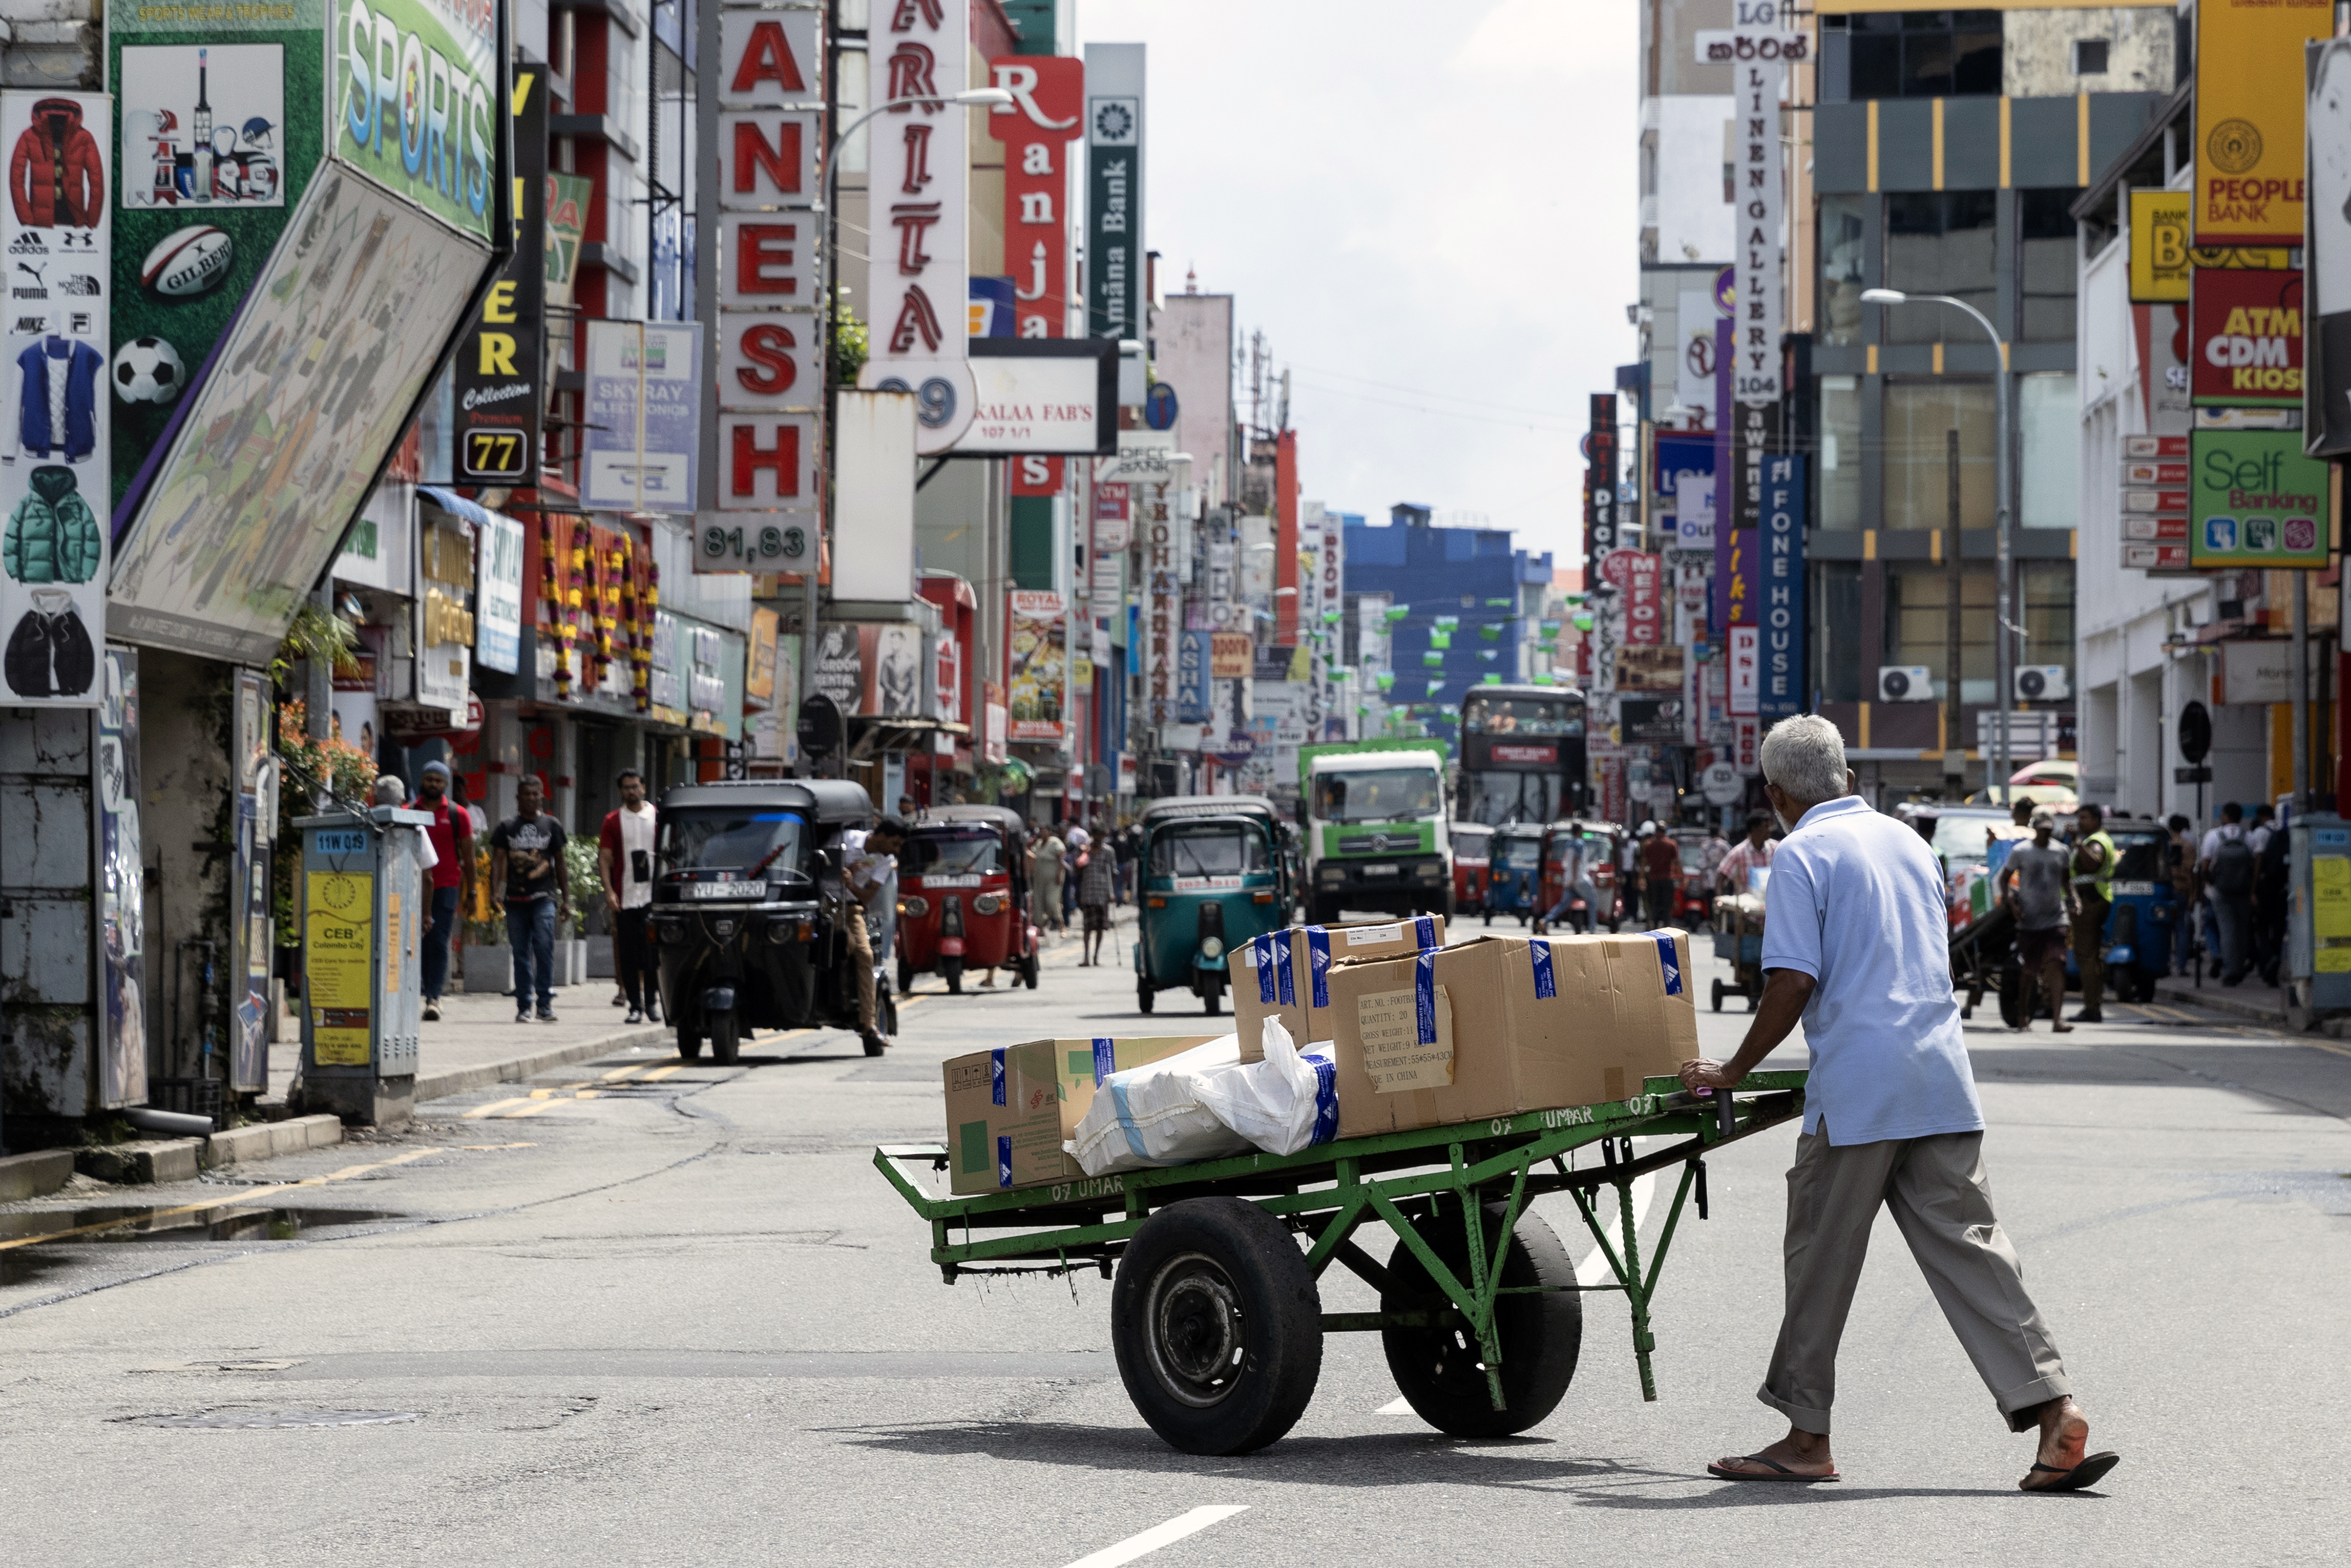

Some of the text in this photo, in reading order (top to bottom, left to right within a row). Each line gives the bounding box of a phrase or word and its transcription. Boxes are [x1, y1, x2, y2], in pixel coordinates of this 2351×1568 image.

[139, 6, 185, 21] SPORTS
[187, 5, 223, 21] WEAR
[236, 4, 294, 19] TROPHIES
[1738, 2, 1774, 25] LG
[349, 2, 489, 216] SPORTS
[1103, 159, 1126, 233] Bank
[2208, 203, 2269, 222] BANK
[8, 245, 49, 254] adidas
[731, 22, 806, 497] ANESH
[166, 239, 232, 290] GILBERT
[12, 287, 48, 300] PUMA
[1748, 202, 1766, 371] GALLERY
[15, 317, 46, 331] NIKE
[2224, 307, 2302, 336] ATM
[2205, 336, 2289, 367] CDM
[1738, 377, 1776, 394] 104
[2233, 368, 2303, 391] KIOS
[463, 383, 531, 410] Collection
[600, 383, 684, 400] SKYRAY
[1043, 403, 1093, 421] FAB'S
[982, 427, 1032, 438] 107 1/1
[474, 435, 515, 470] 77
[2203, 449, 2283, 491] Self
[2229, 490, 2317, 514] Banking
[705, 527, 805, 562] 81,83
[1771, 490, 1791, 577] FONE
[1770, 586, 1791, 696] HOUSE
[1181, 635, 1200, 703] ASHA
[1739, 636, 1753, 686] DSI
[319, 835, 341, 850] 11W
[324, 928, 353, 939] CEB
[350, 942, 364, 950] City
[1361, 1010, 1408, 1025] QUANTITY: 20
[1362, 1030, 1379, 1040] GROSS
[1364, 1045, 1375, 1054] NET
[1386, 1073, 1395, 1083] IN
[1397, 1070, 1418, 1081] CHINA
[1629, 1097, 1652, 1115] 07
[1079, 1175, 1124, 1197] UMAR
